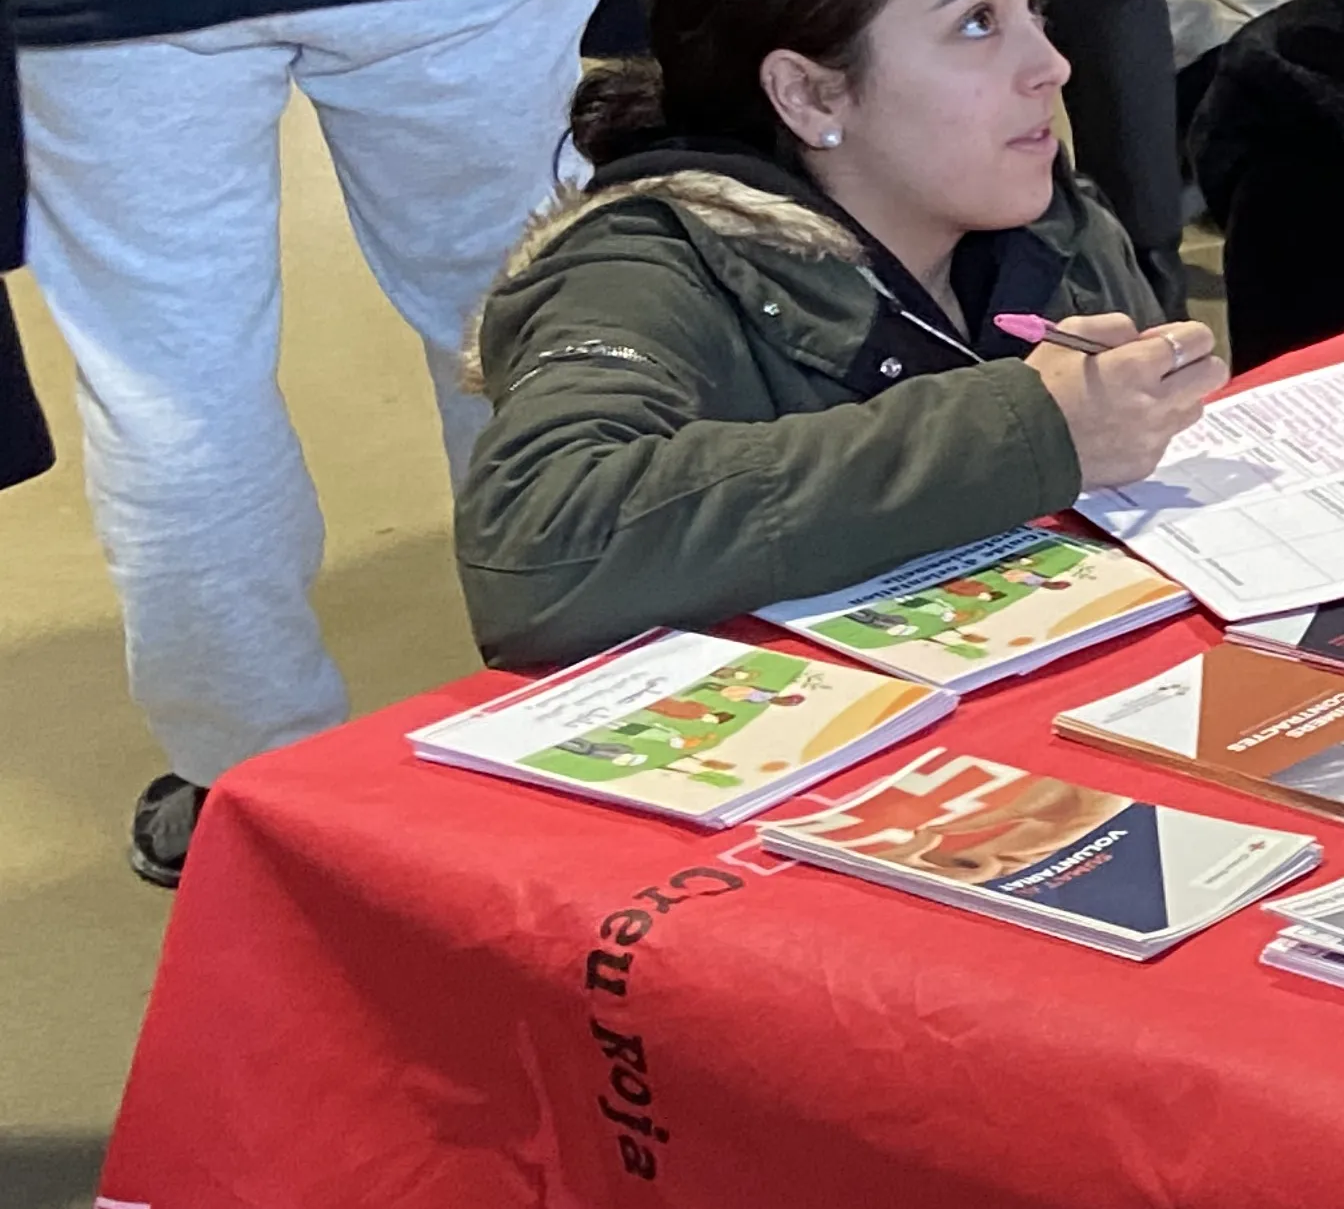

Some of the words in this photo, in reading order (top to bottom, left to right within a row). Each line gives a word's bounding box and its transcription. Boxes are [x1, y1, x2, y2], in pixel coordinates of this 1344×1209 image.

[983, 534, 1039, 558] Guide
[998, 829, 1129, 892] VOLUNTARIAT
[583, 867, 746, 997] Creu
[588, 1016, 671, 1182] Roja
